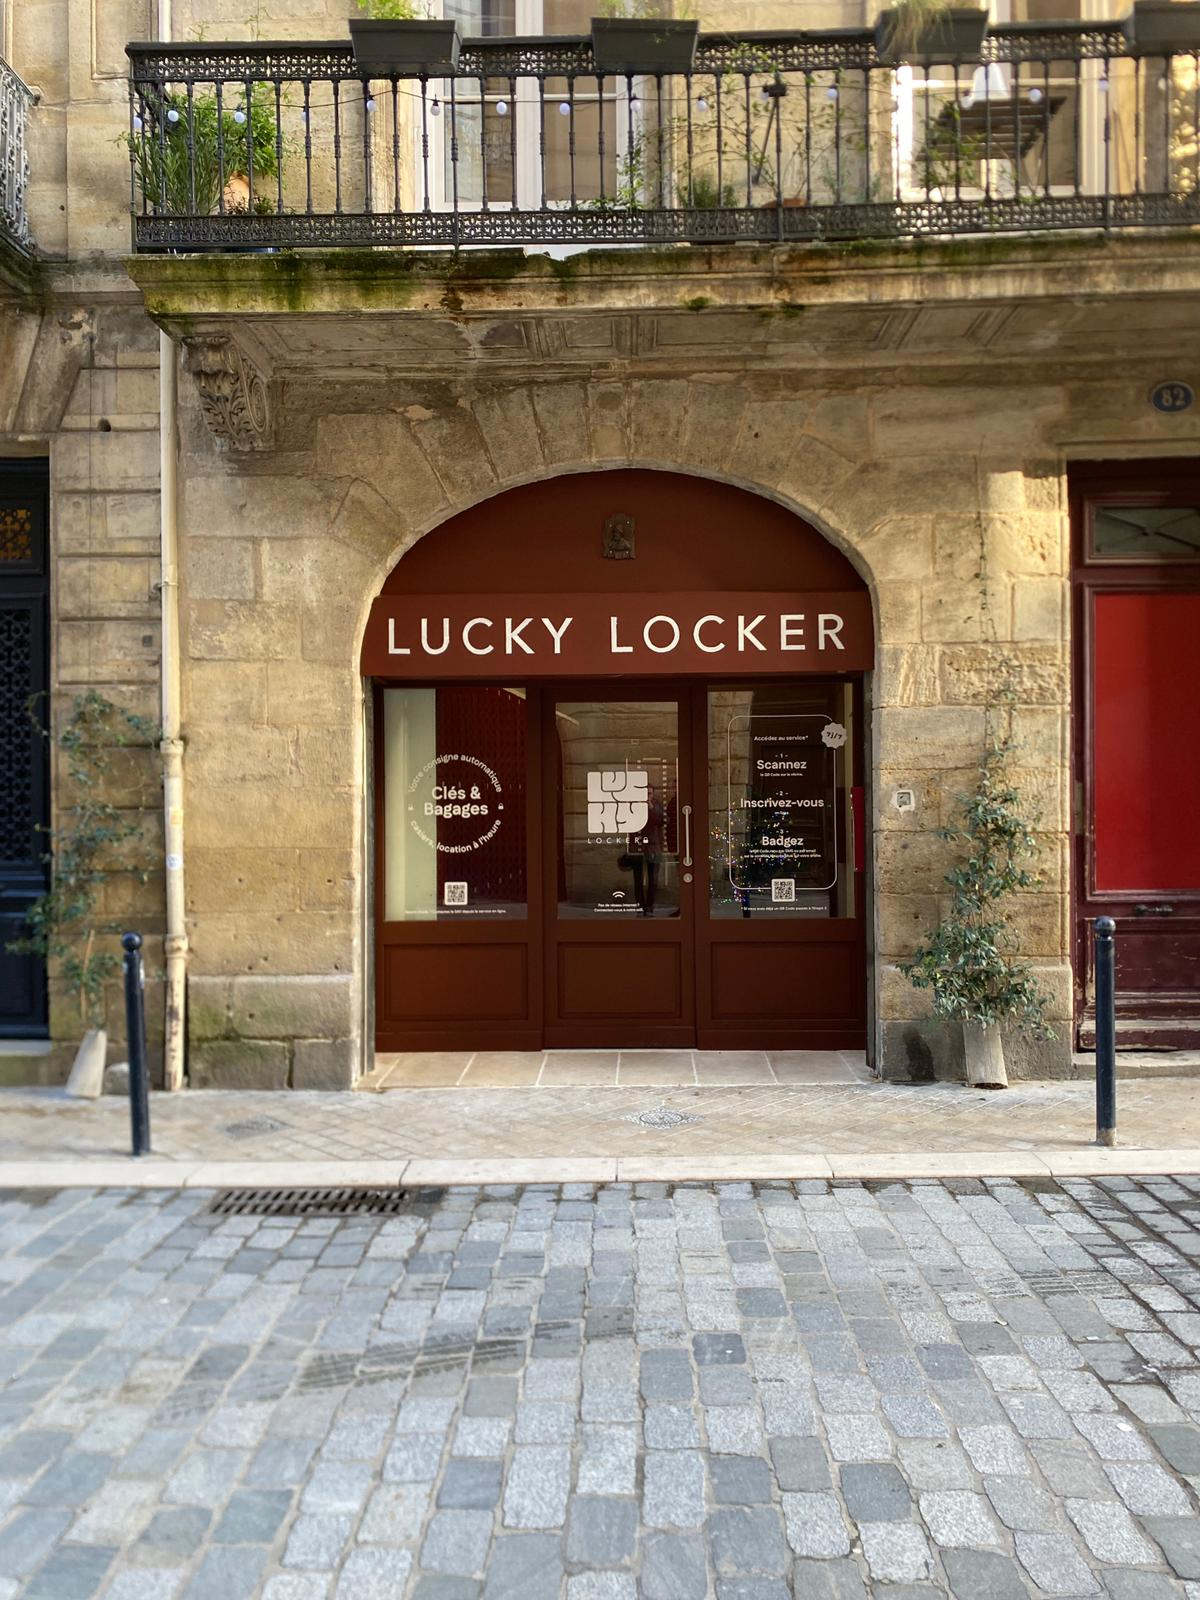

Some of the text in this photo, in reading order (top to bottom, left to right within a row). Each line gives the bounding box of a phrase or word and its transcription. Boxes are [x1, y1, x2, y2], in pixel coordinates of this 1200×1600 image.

[1161, 388, 1185, 406] 82
[388, 613, 845, 655] LUCKY LOCKER
[423, 754, 459, 772] consigne
[460, 754, 502, 792] automatique
[756, 760, 807, 770] Scannez
[431, 786, 481, 800] Clés &
[424, 802, 489, 819] Bagages
[740, 798, 825, 808] Inscrivez-vous
[436, 842, 473, 854] location
[472, 841, 479, 849] à
[478, 820, 502, 845] l'heure
[762, 835, 804, 847] Badgez
